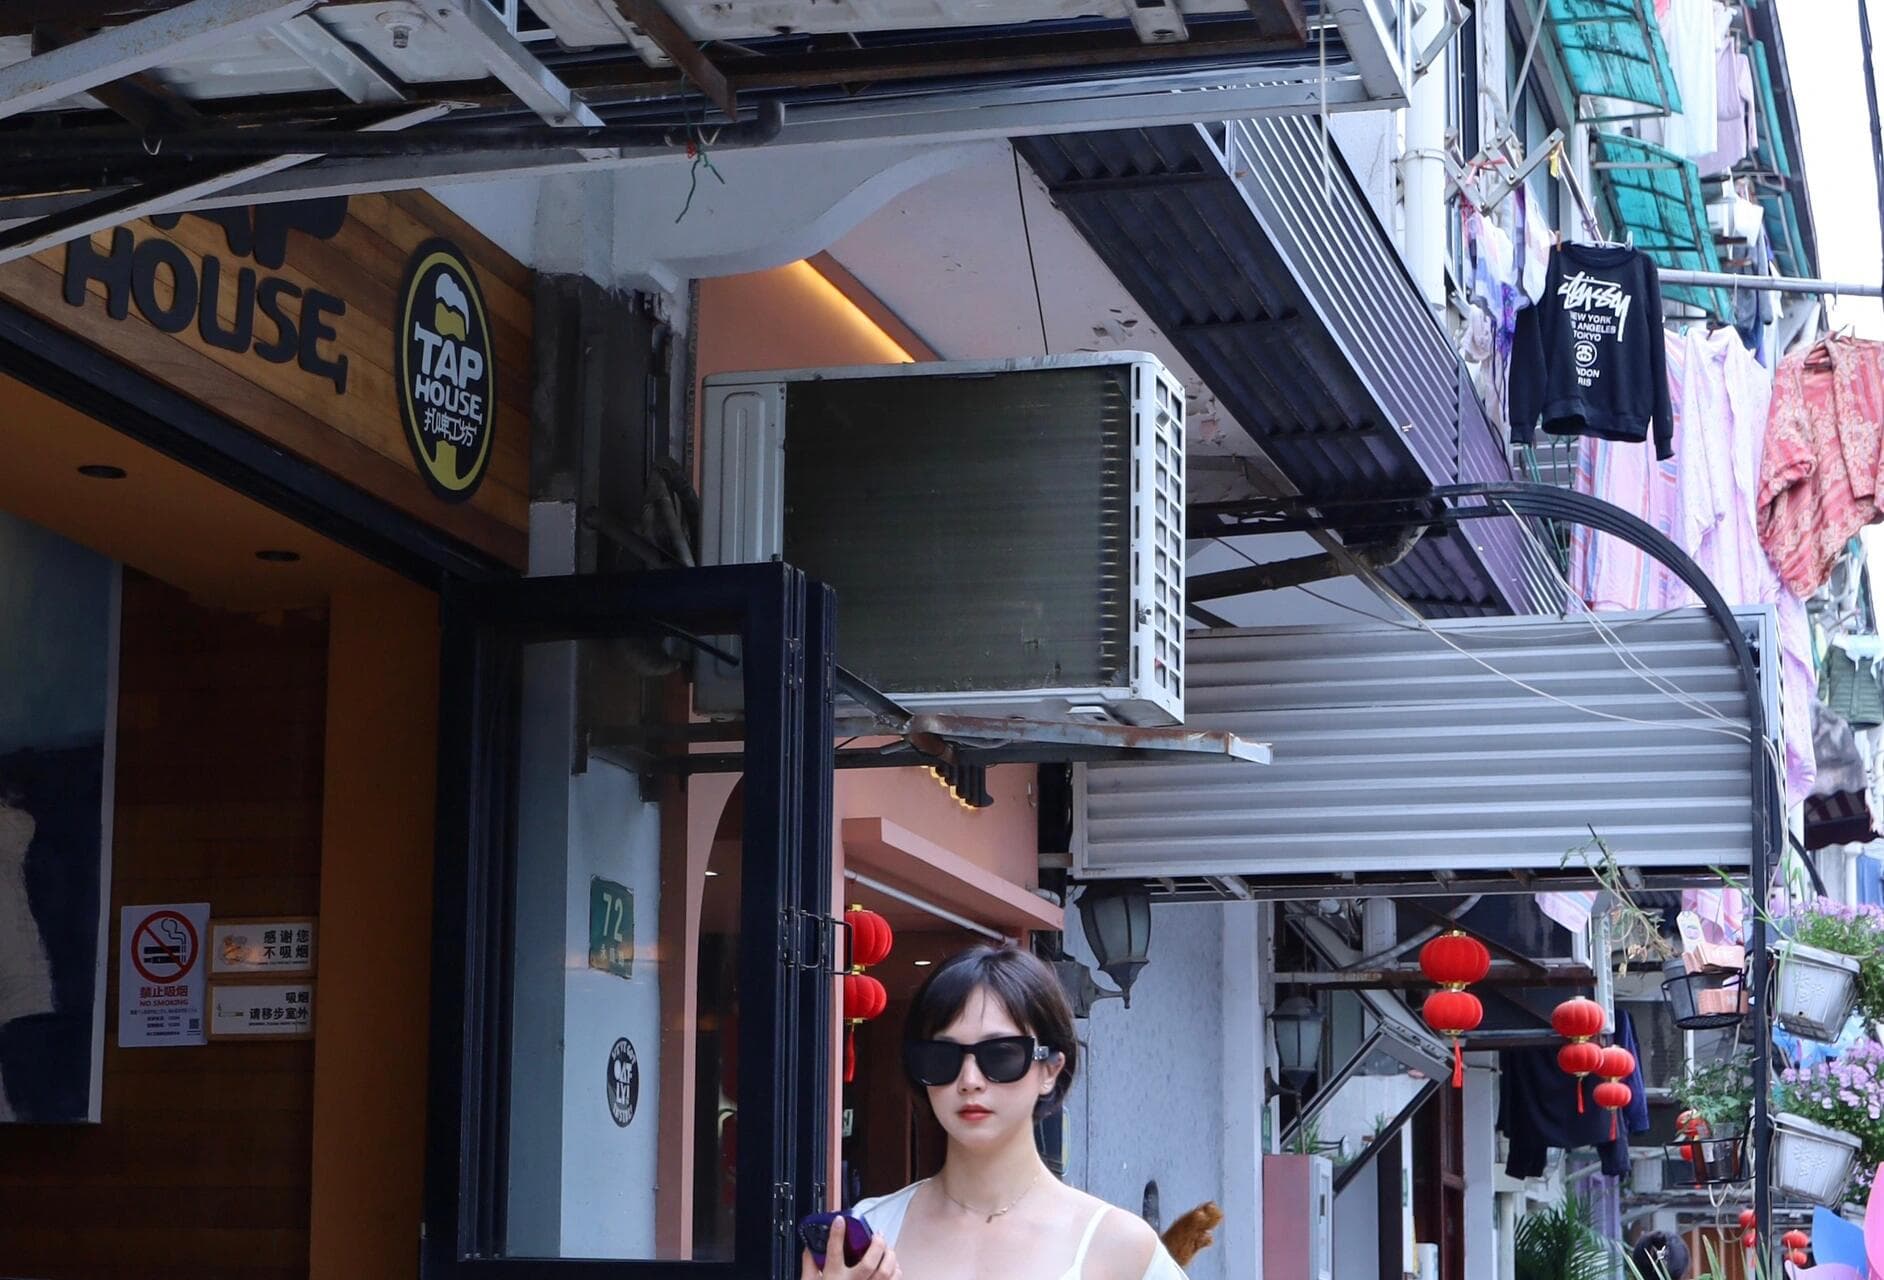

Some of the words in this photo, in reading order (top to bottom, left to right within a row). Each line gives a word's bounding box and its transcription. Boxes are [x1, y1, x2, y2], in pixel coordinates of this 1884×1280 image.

[63, 226, 349, 395] HOUSE
[1588, 314, 1612, 324] YORK
[1578, 323, 1616, 334] ANGELES
[1573, 330, 1601, 342] TOKYO
[414, 321, 484, 390] TAP
[1578, 377, 1592, 387] RIS
[414, 374, 483, 425] HOUSE
[424, 407, 477, 447] 扎啤工坊
[602, 892, 624, 942] 72
[263, 929, 310, 944] 感谢您
[263, 944, 310, 959] 不吸烟
[140, 985, 188, 998] 禁止吸烟
[285, 991, 310, 1004] 吸烟
[140, 999, 151, 1007] NO
[153, 999, 189, 1007] SMOKING
[249, 1007, 310, 1020] 请移步室外
